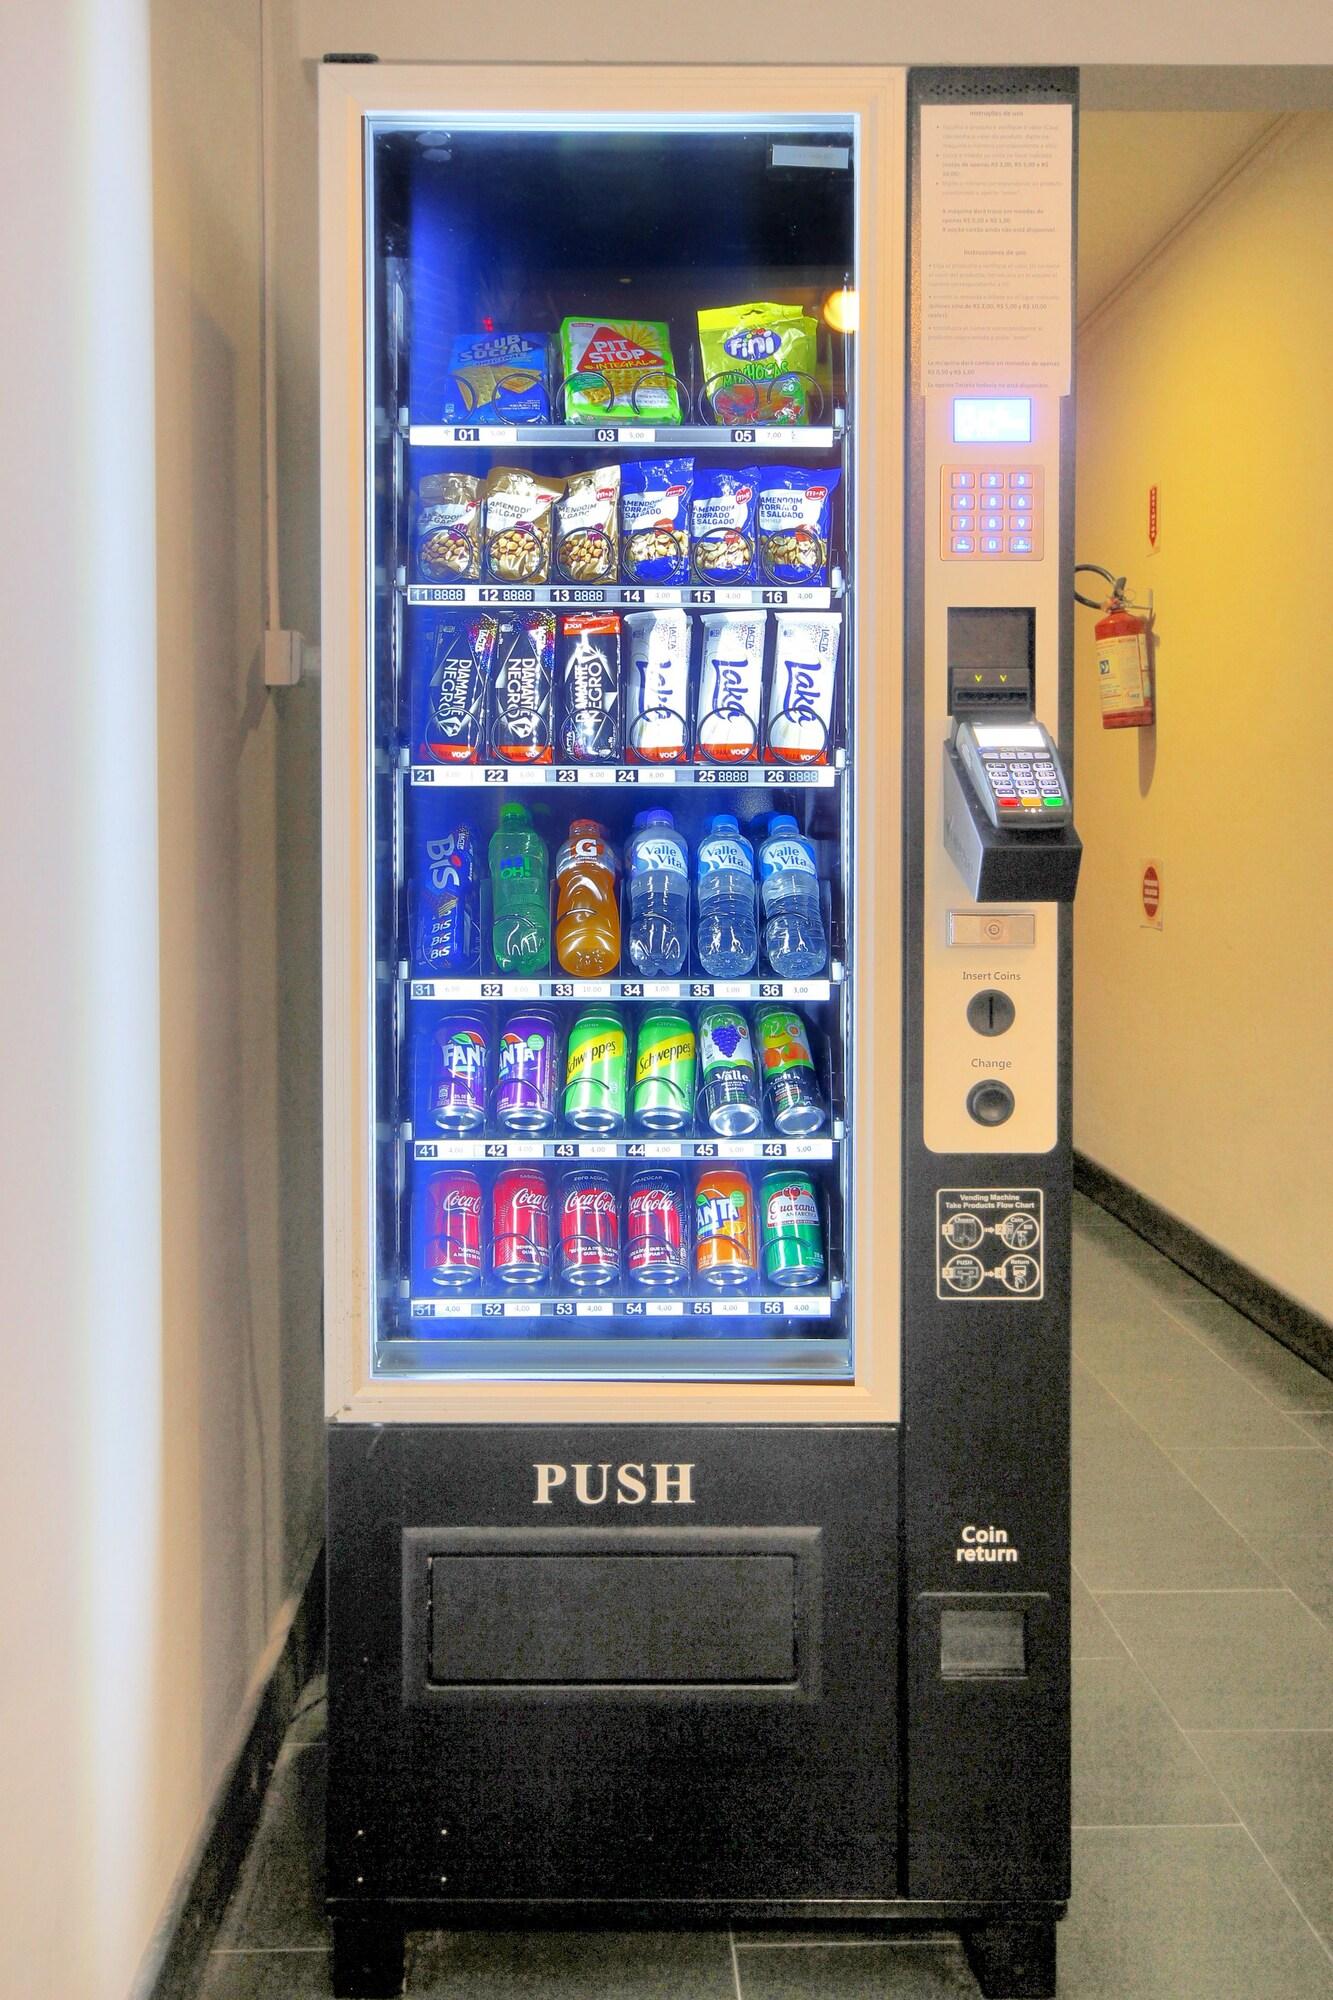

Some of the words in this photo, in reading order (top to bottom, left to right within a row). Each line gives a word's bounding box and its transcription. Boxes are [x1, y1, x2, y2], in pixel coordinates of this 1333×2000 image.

[472, 334, 521, 350] CLUB
[593, 340, 627, 353] PIT
[589, 350, 645, 364] STOP
[595, 360, 649, 371] INTEGRAL
[458, 430, 475, 440] 01
[598, 430, 615, 441] 03
[735, 431, 752, 442] 05
[961, 476, 966, 485] 1
[990, 476, 996, 485] 2
[1018, 476, 1024, 485] 3
[959, 497, 966, 506] 4
[1018, 497, 1025, 506] 6
[766, 511, 804, 519] SALGADO
[960, 519, 966, 527] 7
[1018, 519, 1025, 527] 9
[482, 590, 499, 601] 12
[553, 590, 570, 601] 13
[624, 591, 640, 602] 14
[694, 591, 711, 602] 15
[766, 592, 783, 603] 16
[821, 629, 830, 653] LACTA
[438, 658, 459, 718] NEGRO
[451, 659, 472, 716] DIAMANTE
[507, 658, 522, 719] NEGRO
[520, 659, 536, 716] DIAMANTE
[588, 662, 602, 723] NEGRO
[783, 660, 822, 728] Laka
[416, 770, 432, 781] 21
[487, 770, 505, 781] 22
[558, 770, 576, 782] 23
[618, 770, 635, 782] 24
[699, 771, 716, 782] 25
[768, 771, 784, 782] 26
[575, 839, 598, 857] G
[645, 844, 677, 857] Valle
[707, 844, 738, 858] Valle
[768, 846, 800, 859] Valle
[658, 855, 683, 869] Vita
[718, 855, 744, 867] Vita
[780, 854, 807, 867] Vita
[962, 971, 992, 981] Insert
[994, 971, 1021, 981] Coins
[415, 985, 431, 996] 31
[482, 984, 500, 996] 32
[555, 984, 573, 996] 33
[623, 984, 641, 996] 34
[693, 984, 711, 996] 35
[762, 985, 780, 996] 36
[640, 1042, 691, 1075] Schweppes
[971, 1058, 1012, 1069] Change
[420, 1145, 435, 1157] 41
[487, 1145, 505, 1156] 42
[556, 1145, 574, 1156] 43
[628, 1145, 644, 1156] 44
[696, 1145, 714, 1156] 45
[765, 1144, 782, 1156] 46
[960, 1194, 989, 1202] Vending
[416, 1304, 432, 1316] 51
[485, 1304, 502, 1315] 52
[556, 1304, 573, 1315] 53
[626, 1303, 643, 1314] 54
[694, 1303, 711, 1314] 55
[764, 1302, 781, 1314] 56
[532, 1463, 696, 1505] PUSH
[962, 1526, 1008, 1543] Coin
[956, 1546, 1018, 1562] return
